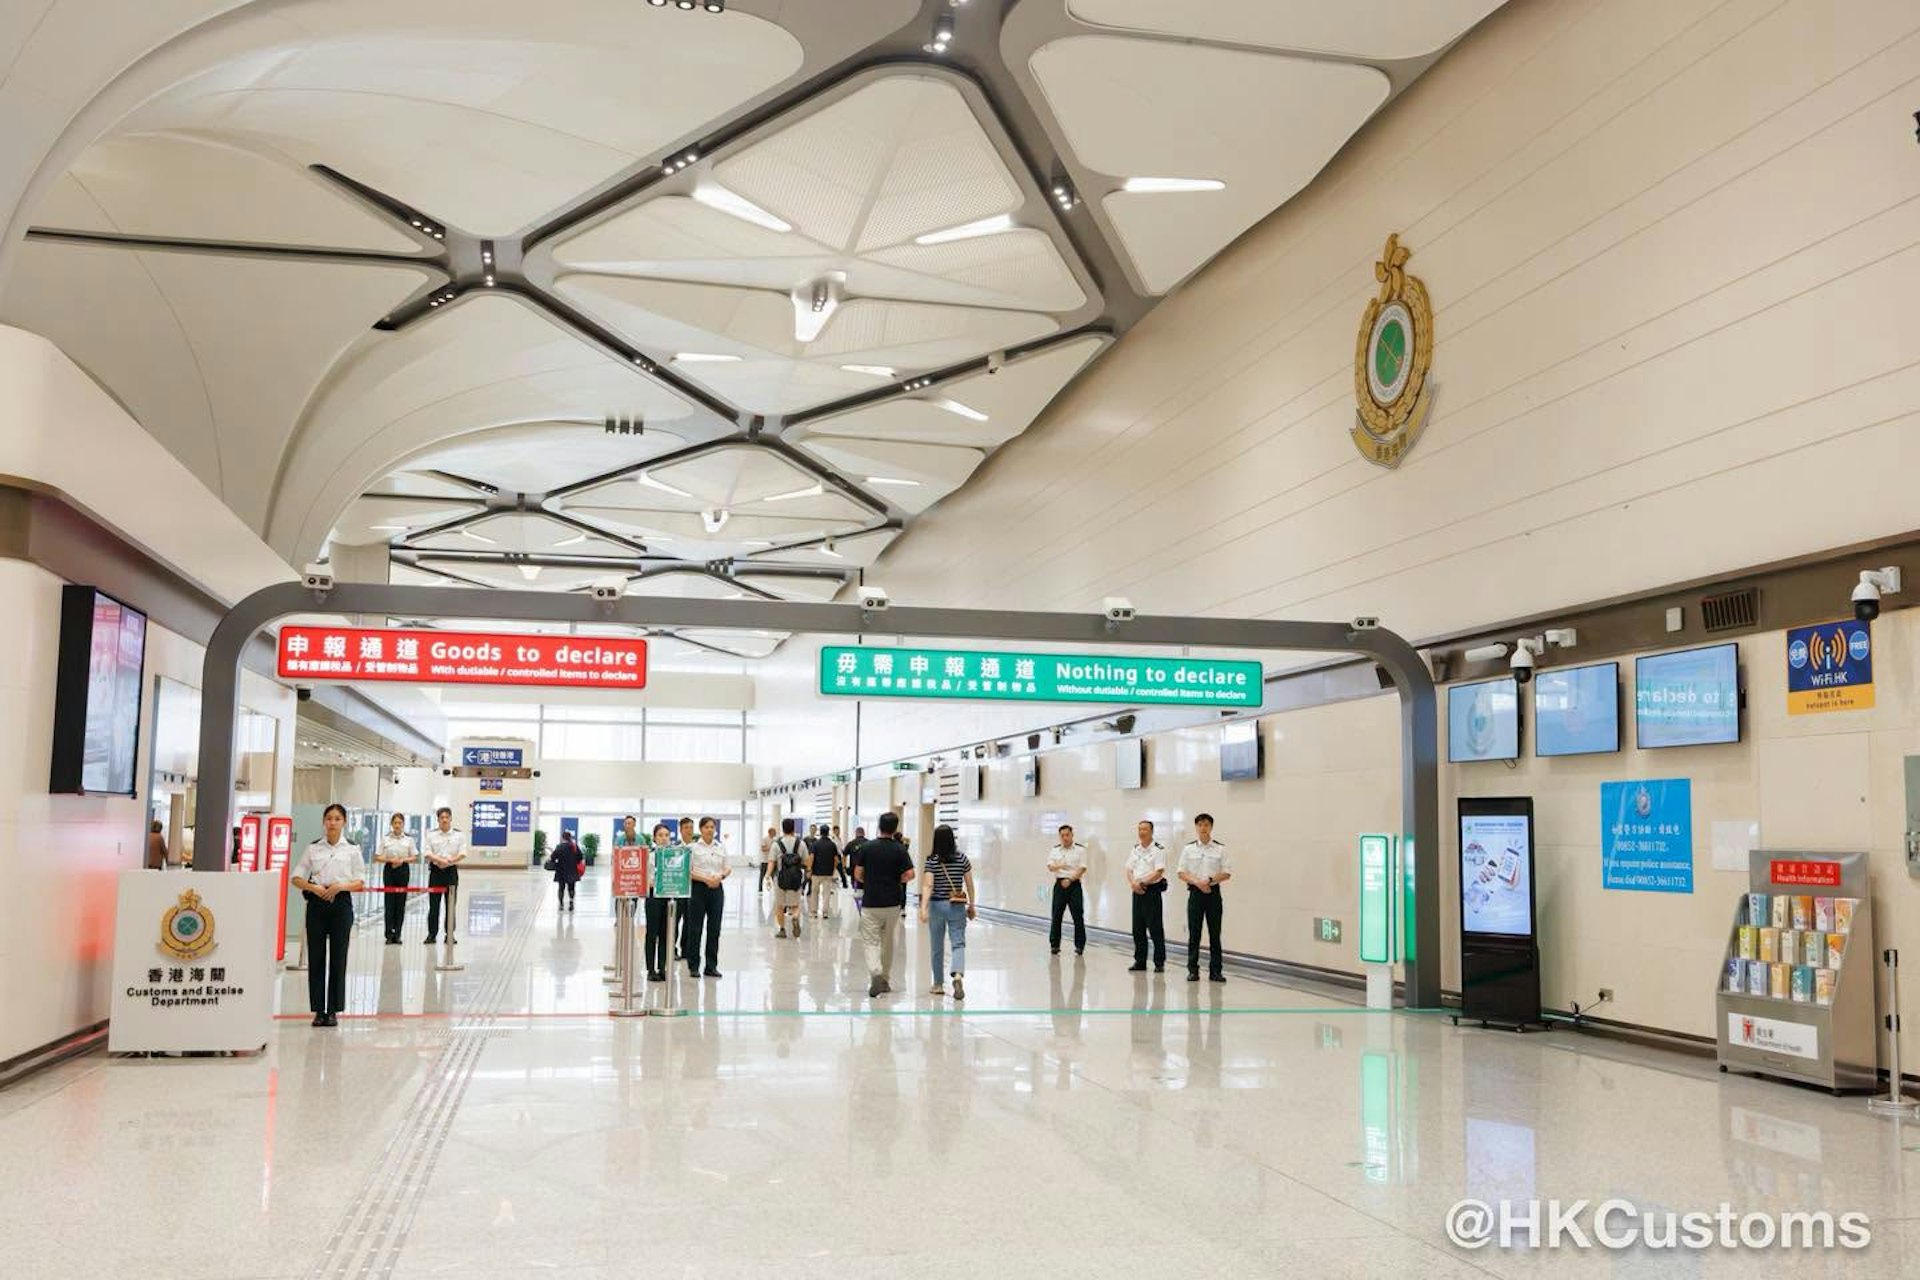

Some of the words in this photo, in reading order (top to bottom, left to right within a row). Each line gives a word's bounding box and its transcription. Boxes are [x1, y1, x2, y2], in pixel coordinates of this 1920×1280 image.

[287, 634, 419, 660] 申報通道
[431, 641, 502, 661] Goods
[517, 646, 540, 663] to
[555, 645, 638, 666] declare
[1850, 640, 1868, 651] FREE
[430, 665, 456, 675] With
[457, 665, 499, 677] dutiable
[507, 667, 558, 679] controlled
[588, 670, 600, 680] to
[600, 670, 639, 682] declare
[836, 652, 1036, 680] 毋需申報通道
[1056, 662, 1138, 686] Nothing
[1146, 666, 1166, 683] to
[1174, 666, 1247, 686] declare
[1056, 684, 1093, 695] Without
[1093, 686, 1129, 697] dutiable
[1136, 687, 1179, 698] controlled
[1205, 690, 1215, 699] to
[1216, 690, 1247, 701] declare
[1776, 873, 1797, 883] Health
[148, 967, 226, 983] 香港海關
[126, 986, 179, 998] Customs
[181, 985, 203, 997] and
[205, 985, 245, 996] Excise
[150, 996, 220, 1008] Department
